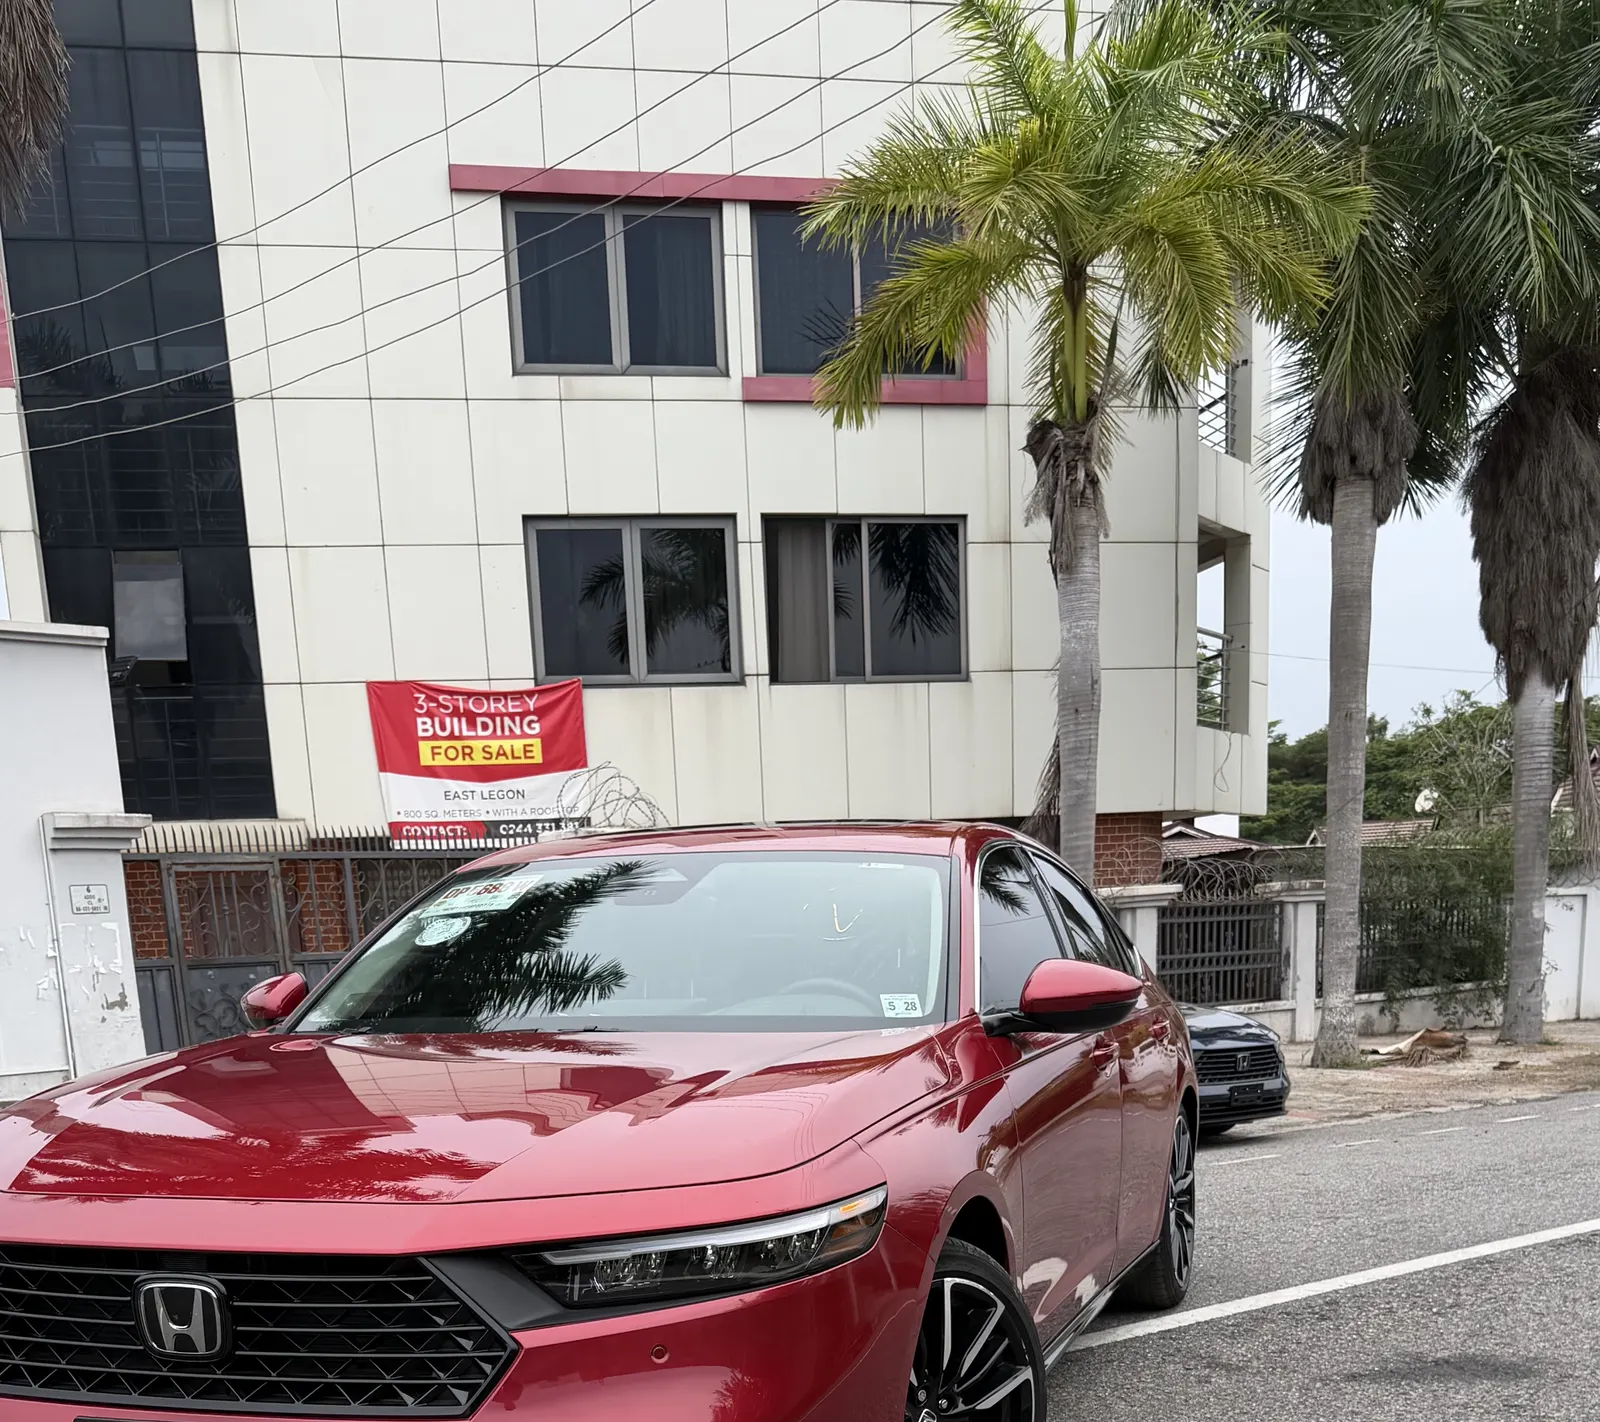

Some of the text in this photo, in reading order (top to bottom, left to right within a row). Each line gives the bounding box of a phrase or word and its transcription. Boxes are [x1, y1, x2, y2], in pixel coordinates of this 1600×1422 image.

[413, 693, 539, 714] 3-STOREY
[416, 715, 541, 737] BUILDING
[430, 744, 535, 761] FOR SALE
[444, 789, 525, 801] EAST LEGON
[403, 810, 422, 819] 800
[443, 809, 482, 818] METERS
[492, 808, 518, 817] WITH
[520, 808, 527, 816] A
[402, 825, 468, 836] CONTACT:
[888, 1001, 918, 1011] 5 28
